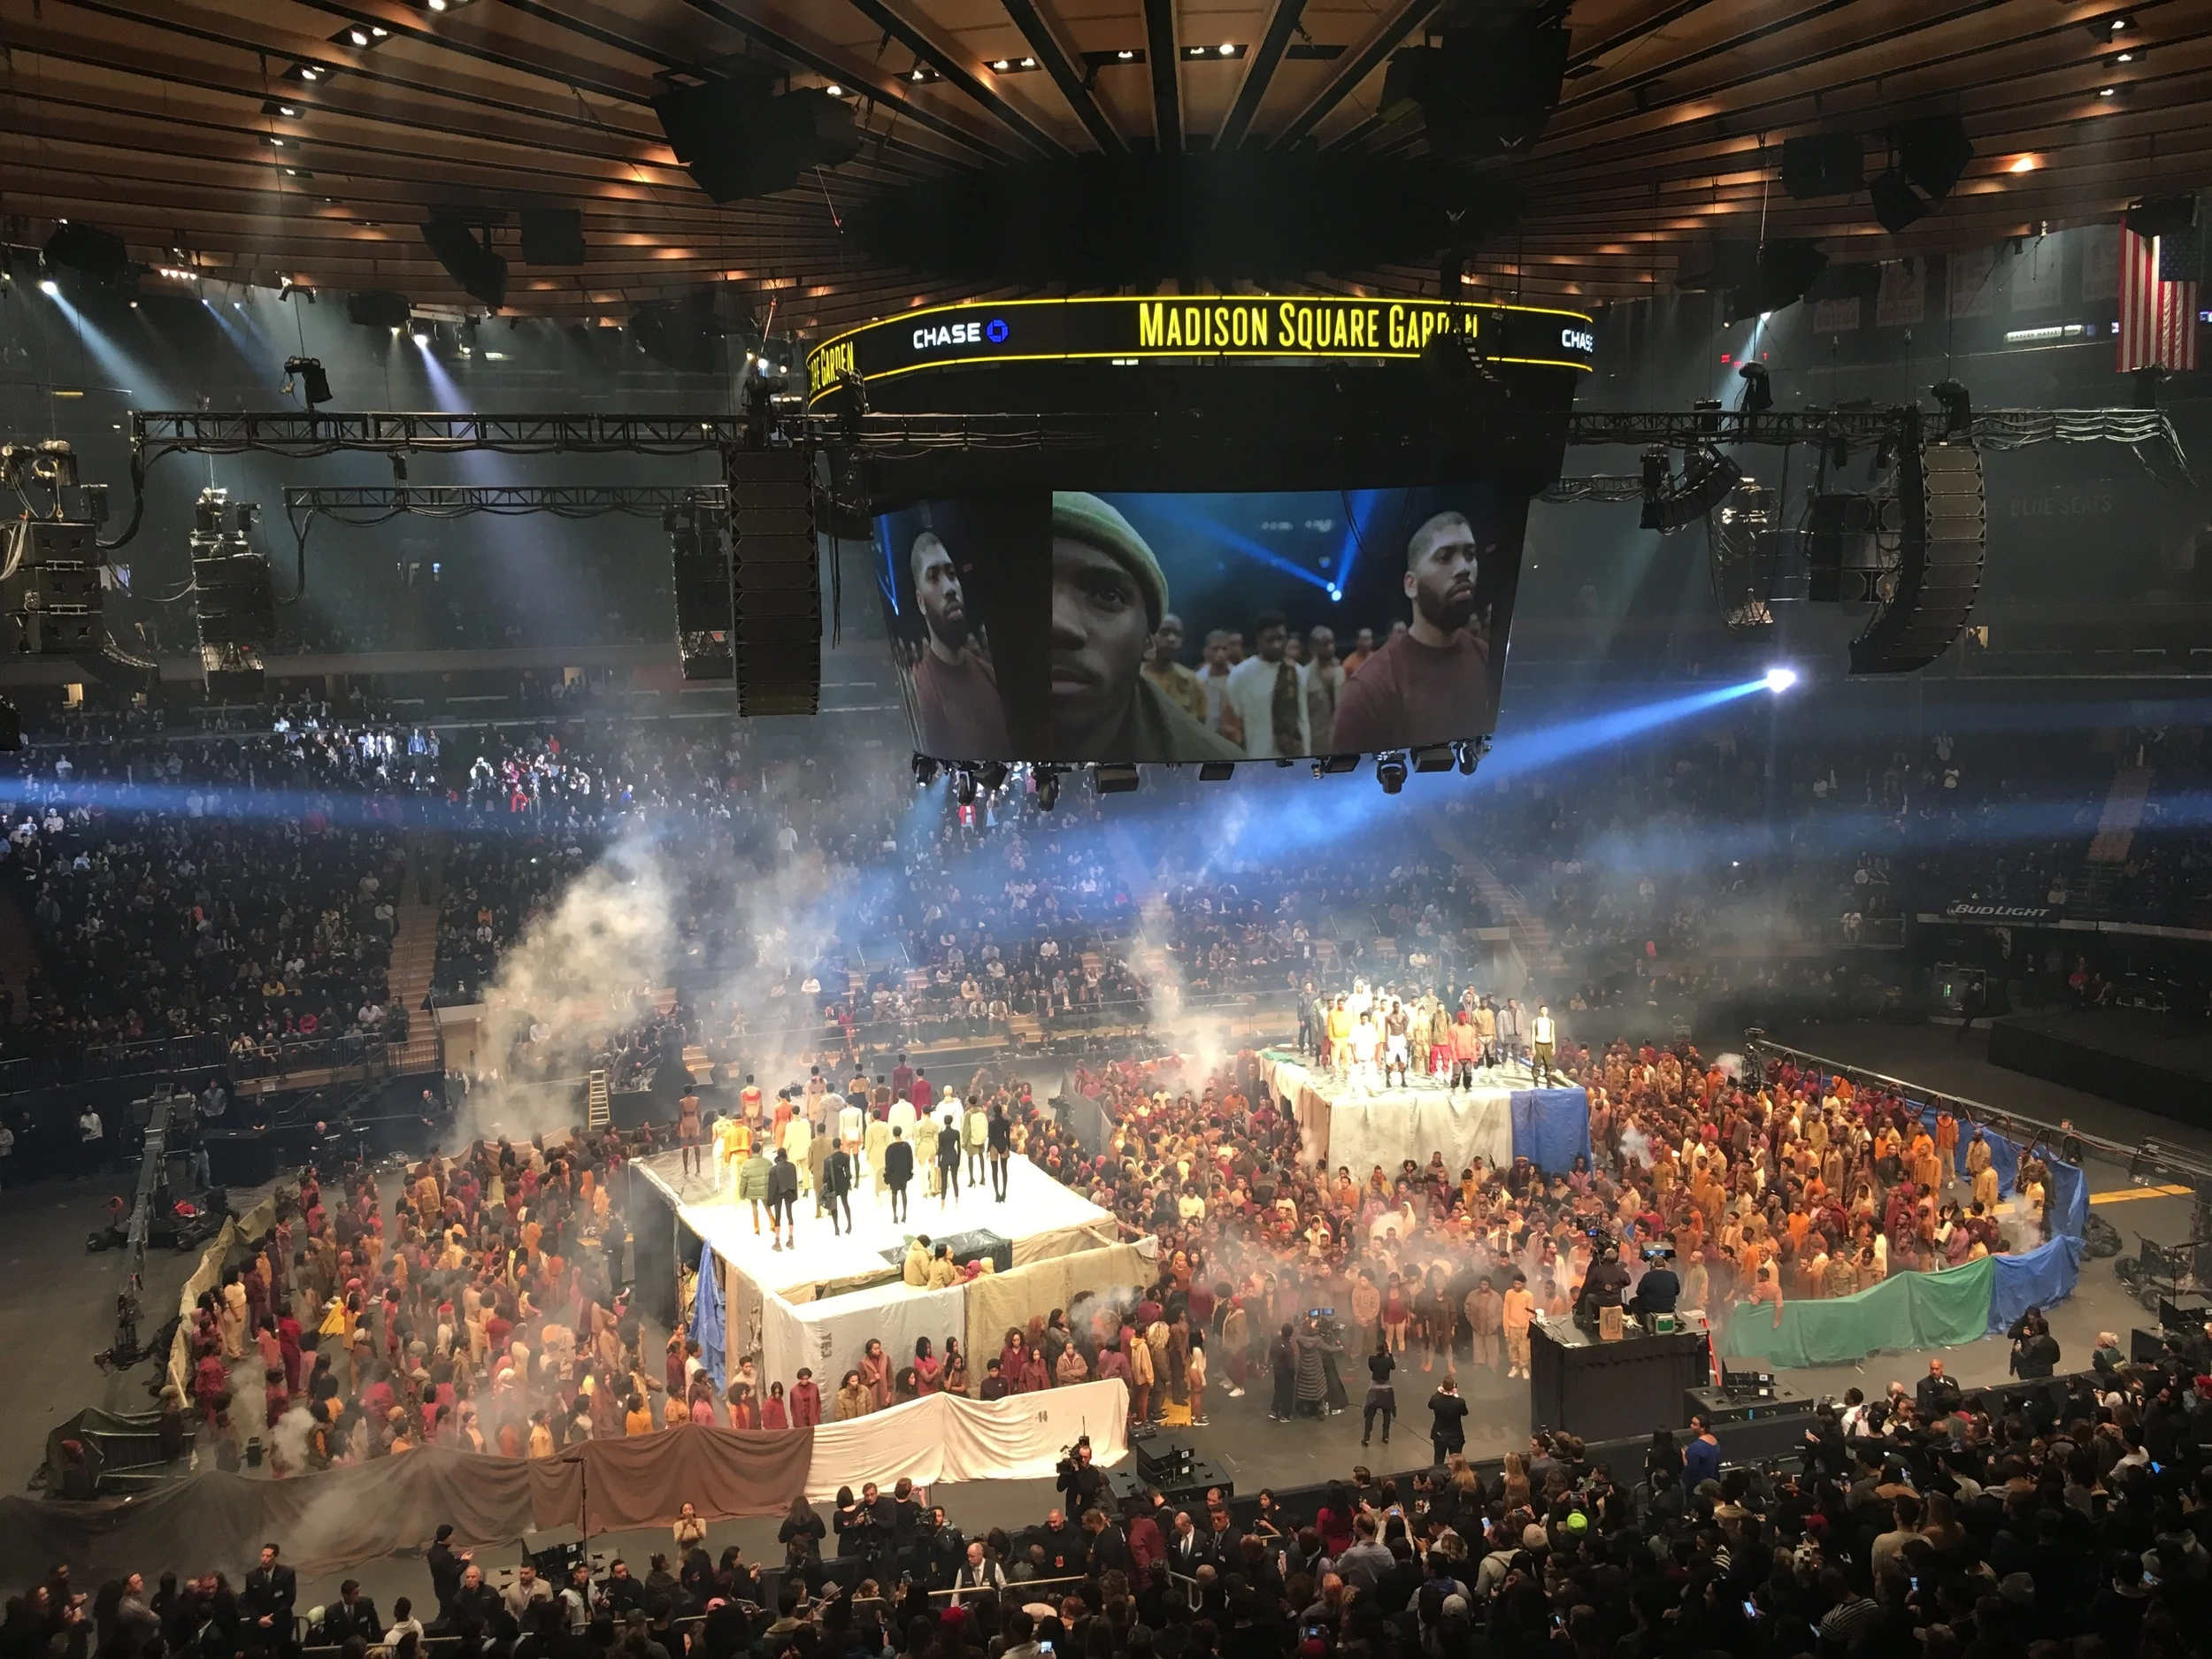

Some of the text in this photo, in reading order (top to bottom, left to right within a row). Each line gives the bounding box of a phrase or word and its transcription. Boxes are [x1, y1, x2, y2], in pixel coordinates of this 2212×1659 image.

[913, 322, 981, 349] CHASE
[1140, 303, 1267, 347] MADISON
[1279, 303, 1379, 350] SQUARE
[2011, 494, 2113, 518] BLUE SEATS
